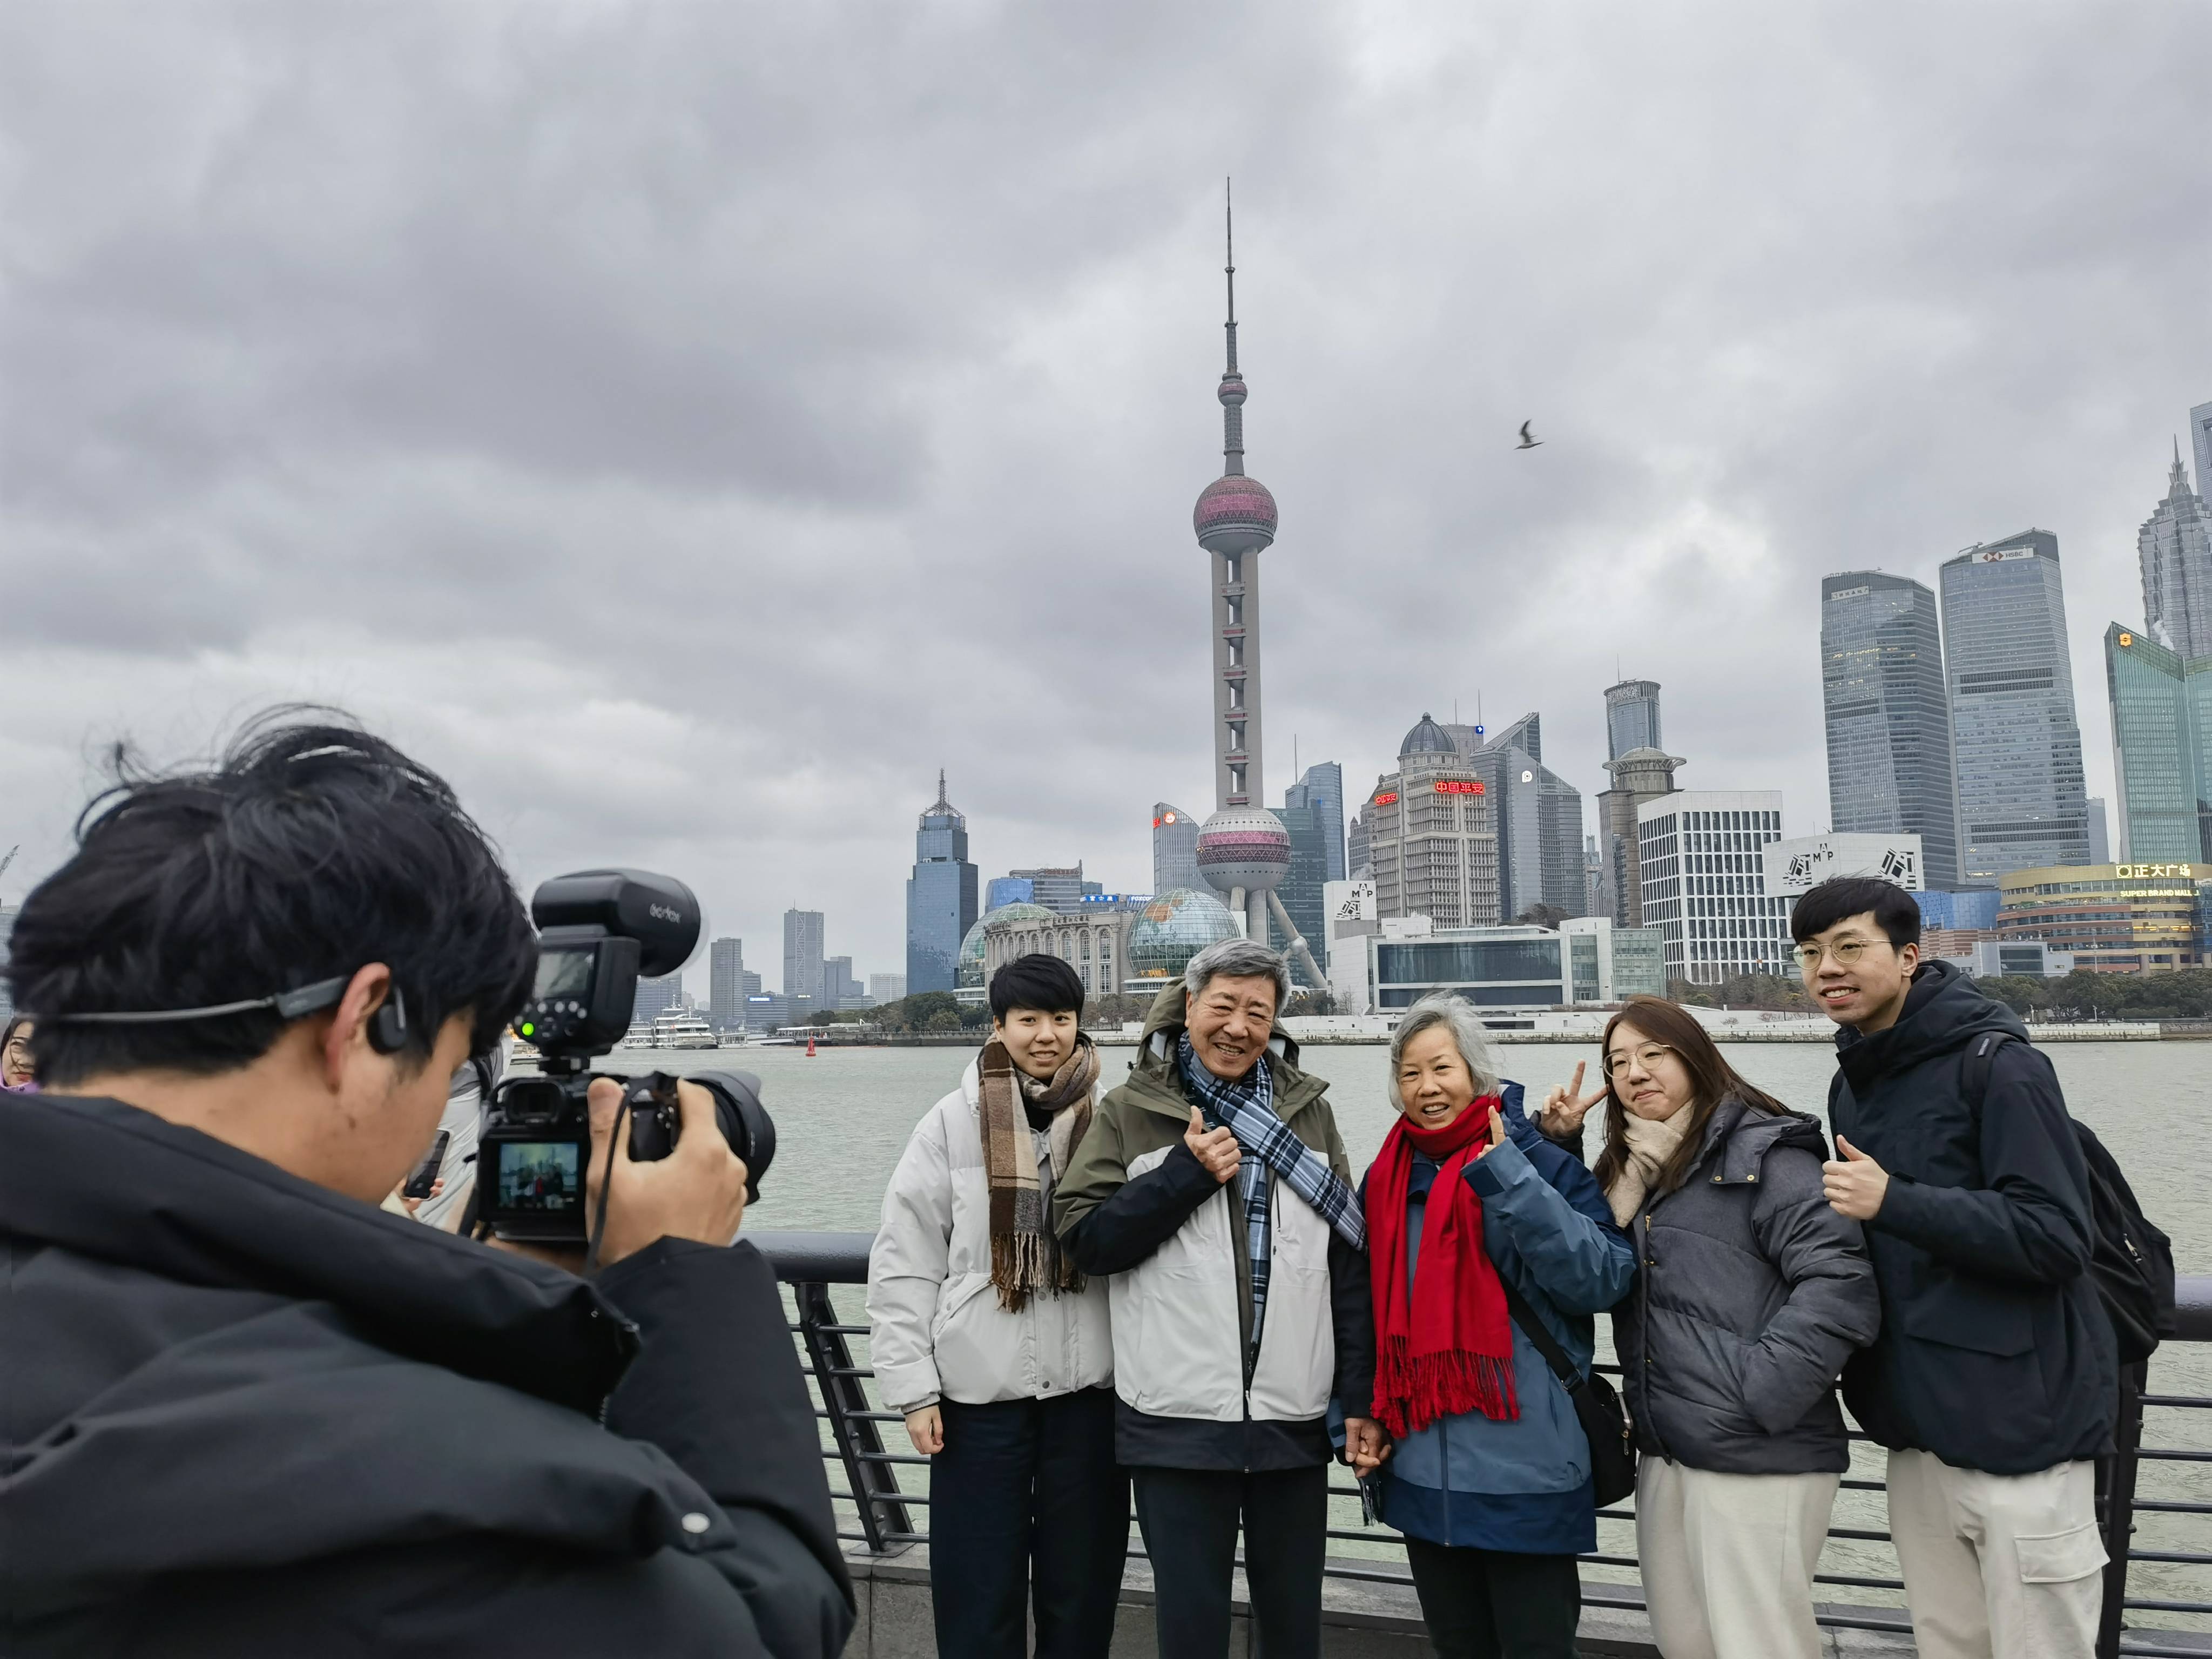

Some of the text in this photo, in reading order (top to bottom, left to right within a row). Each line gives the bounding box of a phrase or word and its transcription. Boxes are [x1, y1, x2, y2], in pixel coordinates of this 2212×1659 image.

[1436, 782, 1483, 793] 中国平安
[2134, 864, 2191, 878] 正大广场
